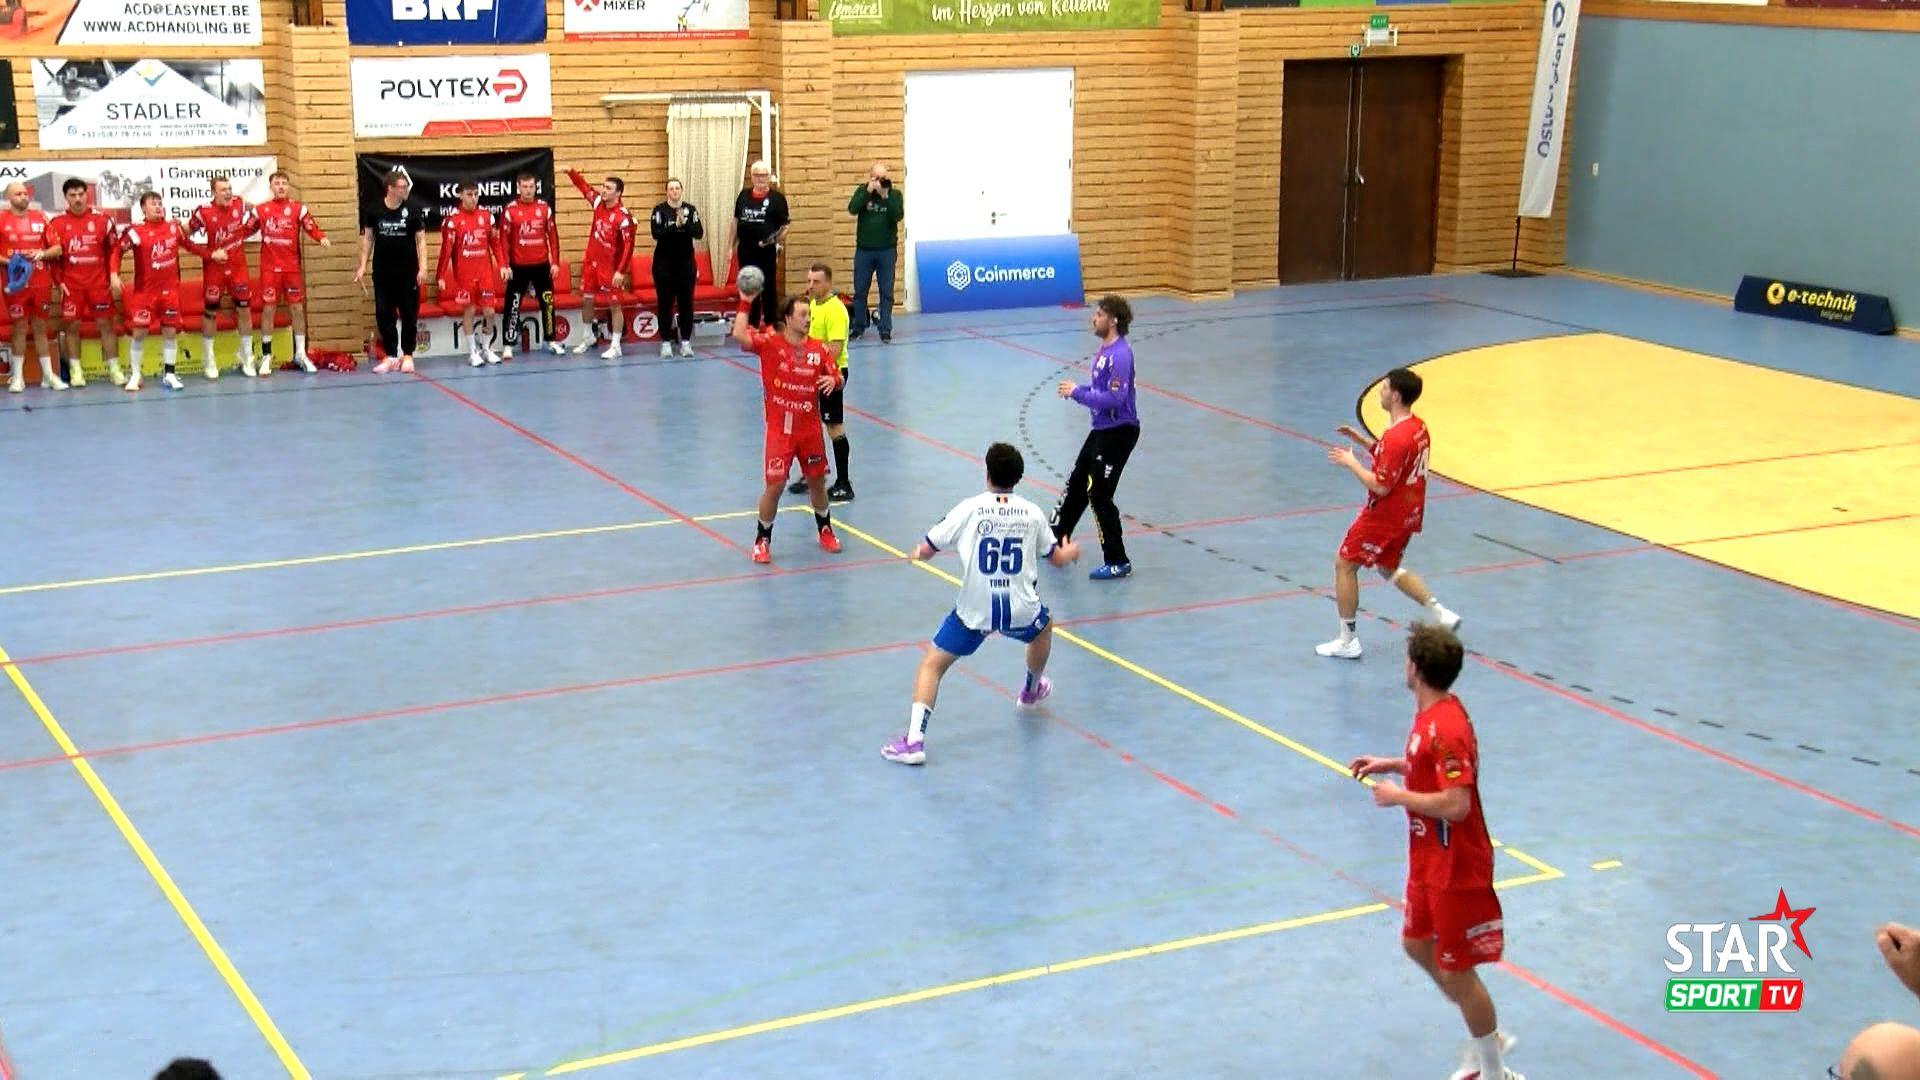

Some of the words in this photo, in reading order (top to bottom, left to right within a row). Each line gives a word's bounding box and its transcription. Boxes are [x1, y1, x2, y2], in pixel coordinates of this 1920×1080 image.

[123, 3, 251, 16] ACD@EASYNET.BE
[83, 20, 251, 34] WWW.ACDHANDLING.BE
[381, 77, 490, 100] POLYTEX
[106, 102, 201, 120] STADLER
[974, 265, 1055, 283] Coinmerce
[1787, 288, 1857, 313] e-technik
[978, 537, 1024, 576] 65
